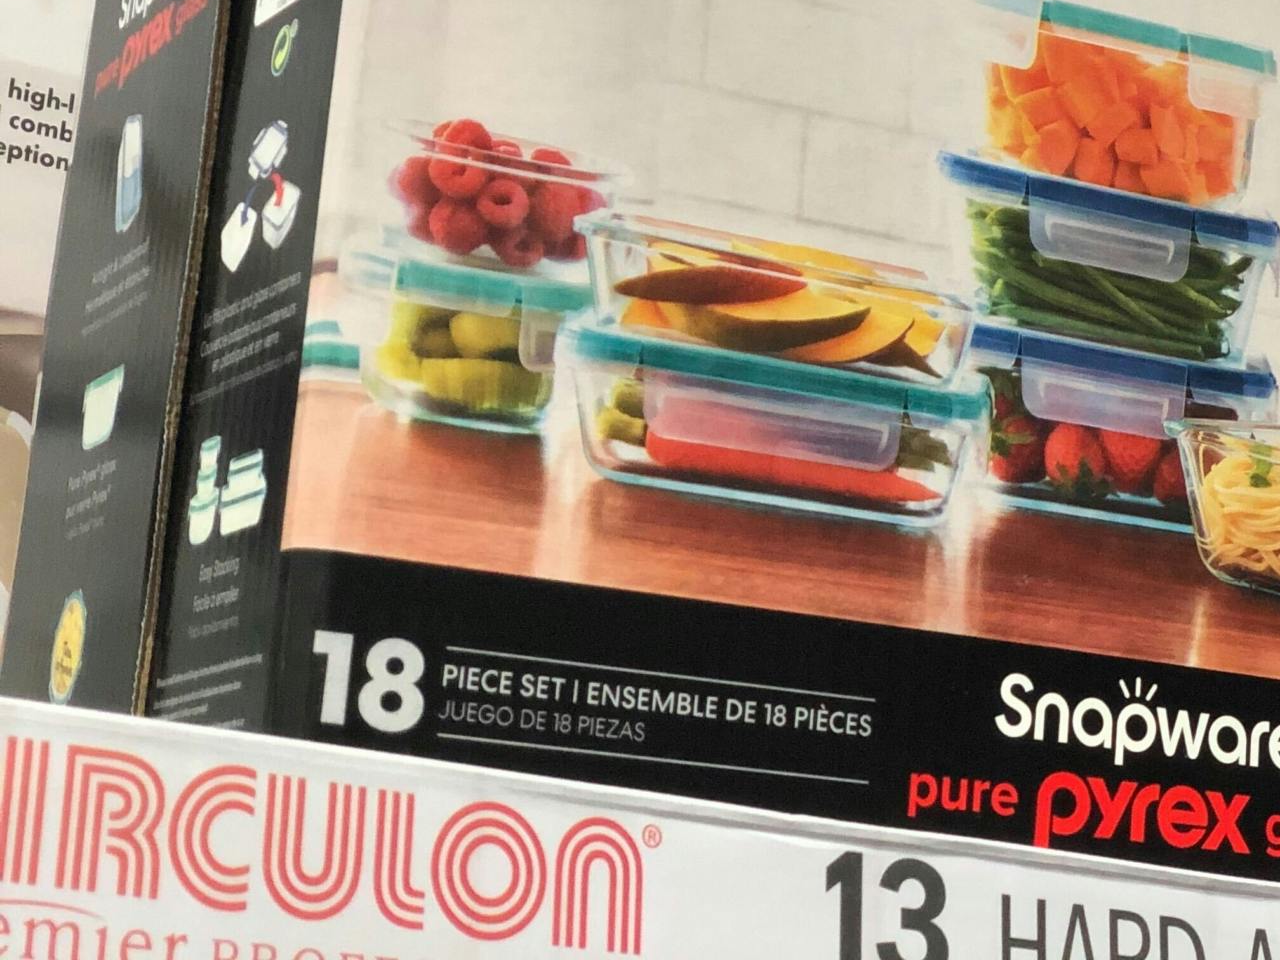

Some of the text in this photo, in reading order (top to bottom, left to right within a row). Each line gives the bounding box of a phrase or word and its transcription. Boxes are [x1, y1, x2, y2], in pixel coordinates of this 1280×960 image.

[9, 115, 73, 143] comb
[311, 629, 425, 733] 18
[441, 663, 872, 737] PIECE SET ENSEMBLE DE 18 PIÈCES
[438, 700, 646, 742] JUEGO DE 18 PIEZAS
[906, 771, 1019, 818] pure
[1033, 771, 1251, 855] pyrex
[825, 851, 949, 960] 13
